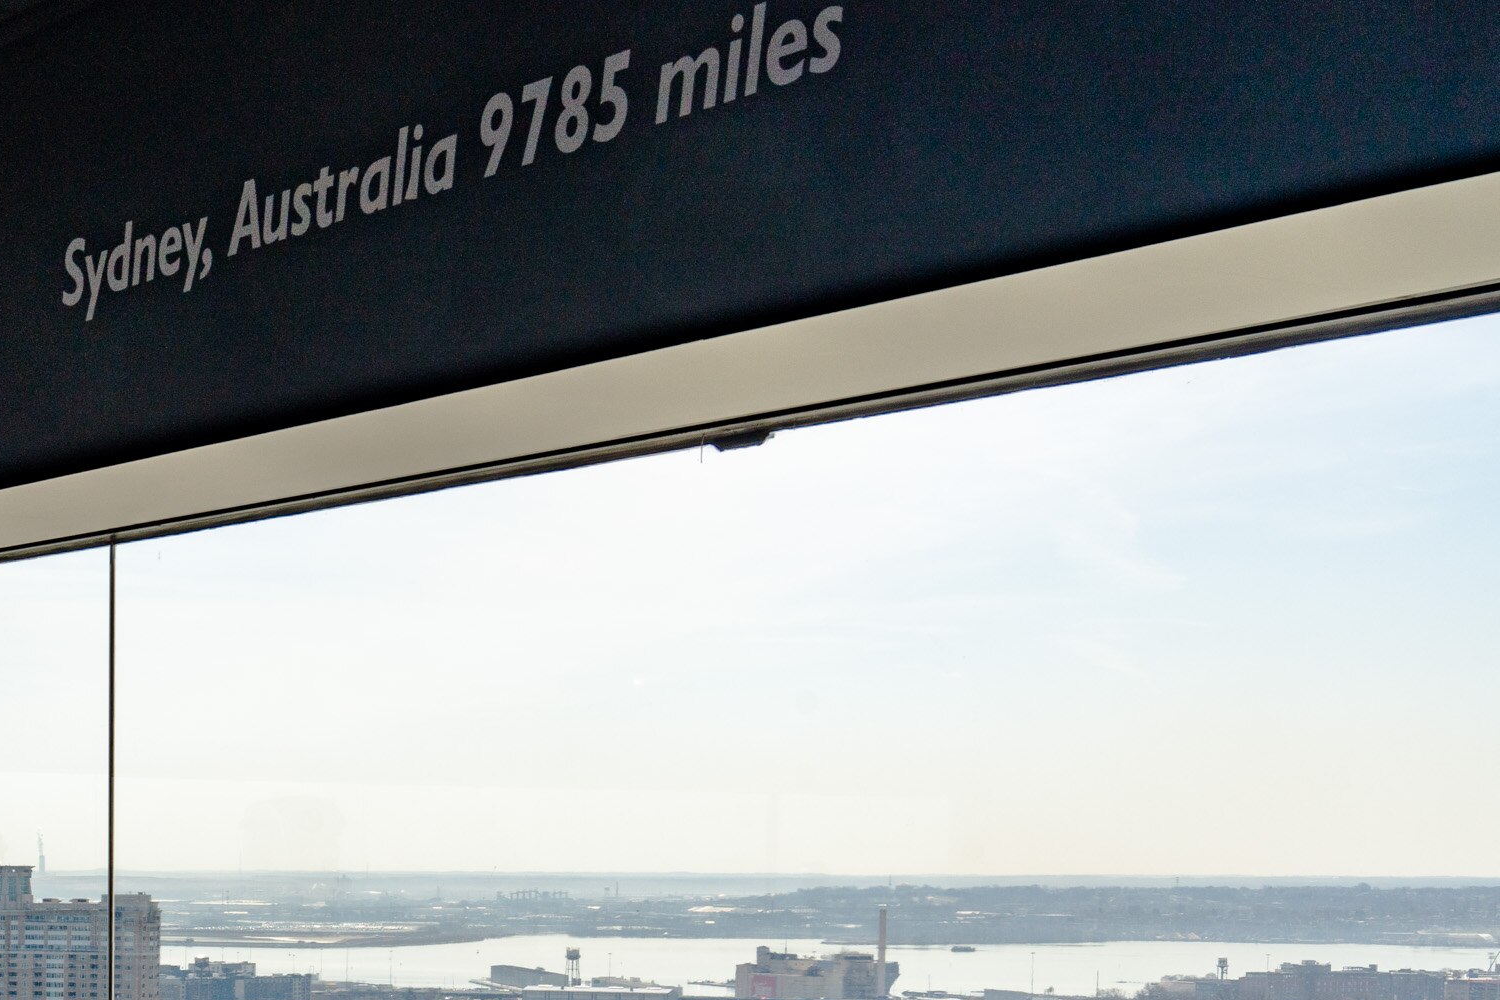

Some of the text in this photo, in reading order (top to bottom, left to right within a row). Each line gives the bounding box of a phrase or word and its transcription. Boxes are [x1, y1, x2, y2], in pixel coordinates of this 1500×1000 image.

[61, 2, 844, 322] Sydney, Australia 9785 miles
